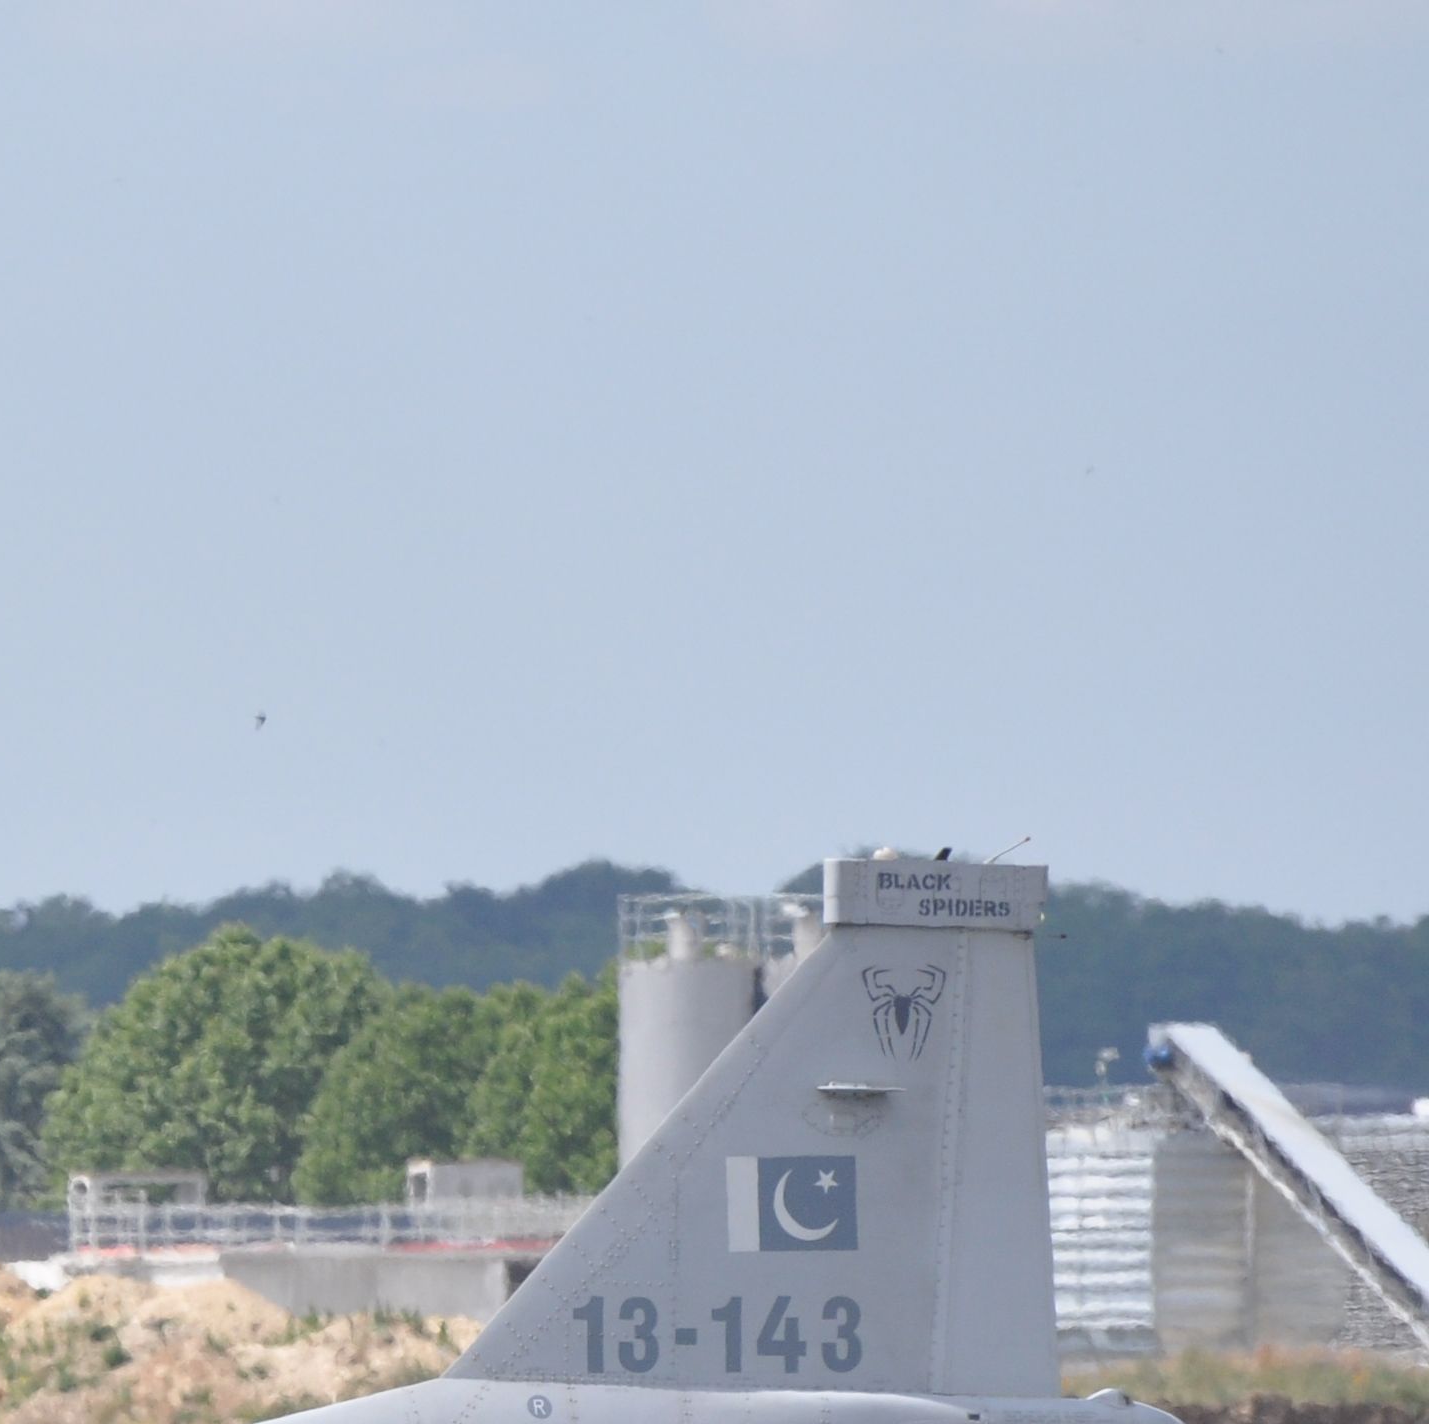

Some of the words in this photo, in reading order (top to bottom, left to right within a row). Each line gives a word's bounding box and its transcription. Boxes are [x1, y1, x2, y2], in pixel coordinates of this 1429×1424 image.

[878, 872, 952, 891] BLACK
[918, 898, 1011, 917] SPIDERS
[572, 1295, 863, 1374] 13-143
